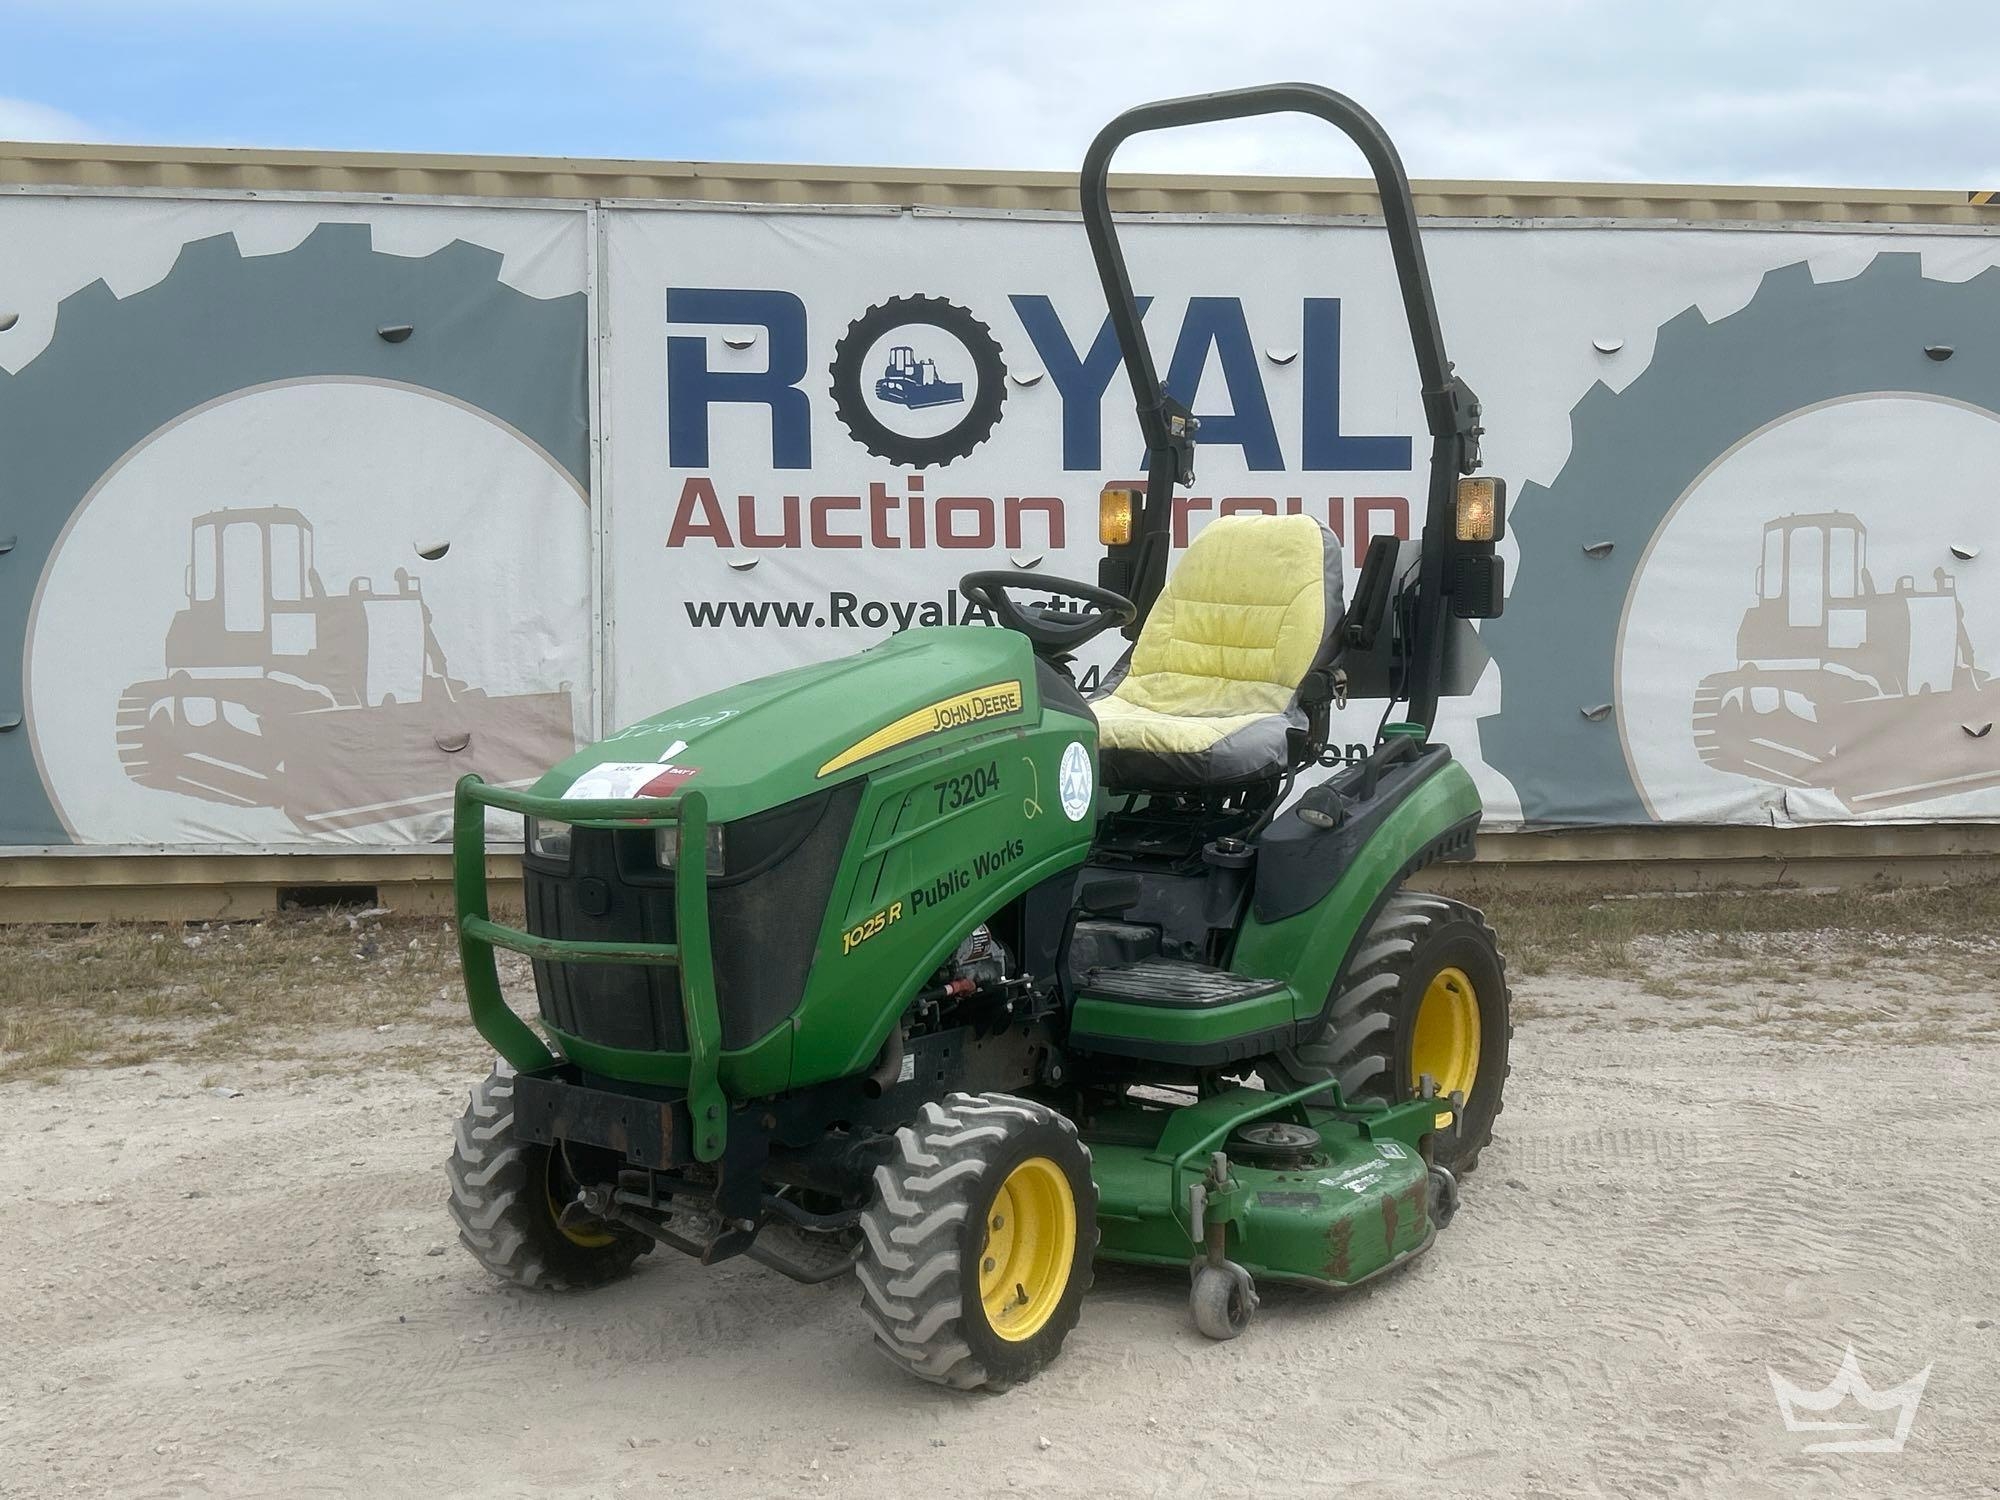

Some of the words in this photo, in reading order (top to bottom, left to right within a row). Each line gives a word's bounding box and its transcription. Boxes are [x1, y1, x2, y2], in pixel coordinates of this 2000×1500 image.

[666, 287, 1413, 472] ROYAL
[666, 475, 1065, 549] Auction
[933, 703, 971, 730] JOHN
[972, 693, 1017, 717] DEERE
[933, 760, 1000, 815] 73204
[910, 869, 971, 916] Public
[973, 838, 1024, 880] Works
